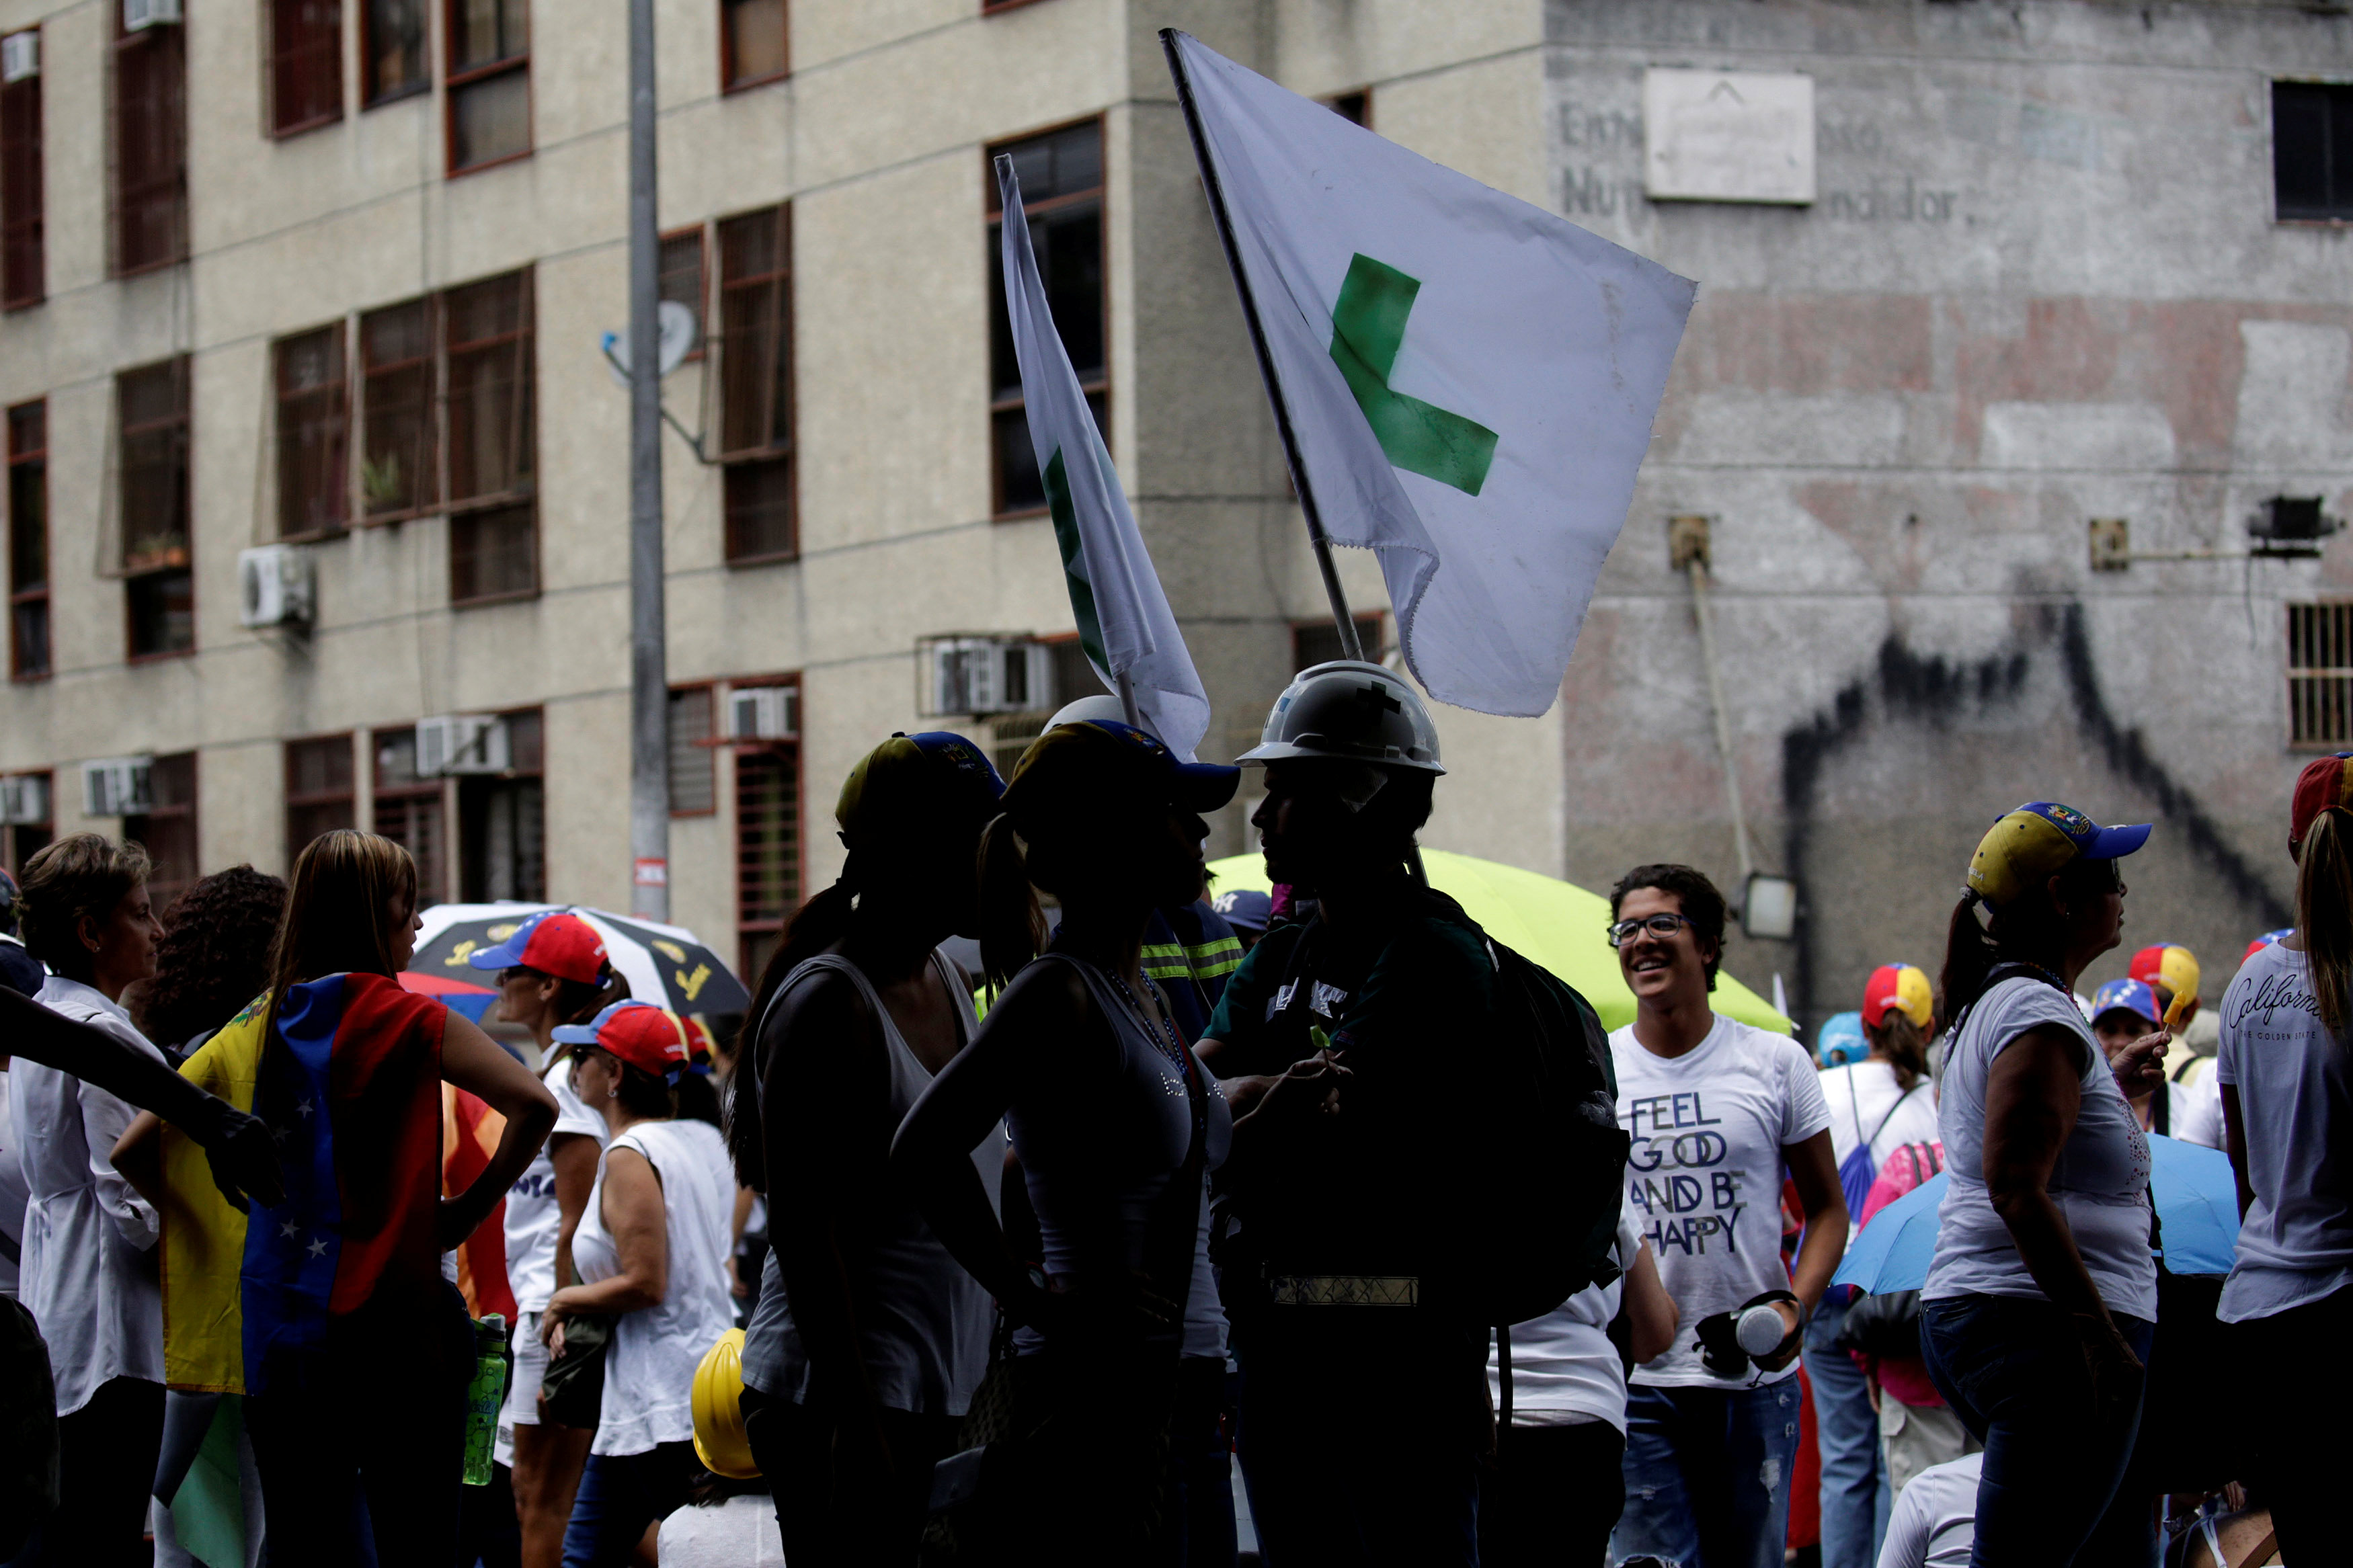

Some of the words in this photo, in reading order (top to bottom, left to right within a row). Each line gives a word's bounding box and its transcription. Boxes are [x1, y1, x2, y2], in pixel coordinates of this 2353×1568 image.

[2258, 1032, 2290, 1040] GOLDEN
[2295, 1031, 2316, 1039] STATE
[1632, 1091, 1722, 1140] FEEL
[1628, 1130, 1727, 1172] GOOD
[1630, 1175, 1703, 1215] AND
[1711, 1170, 1747, 1210] BE
